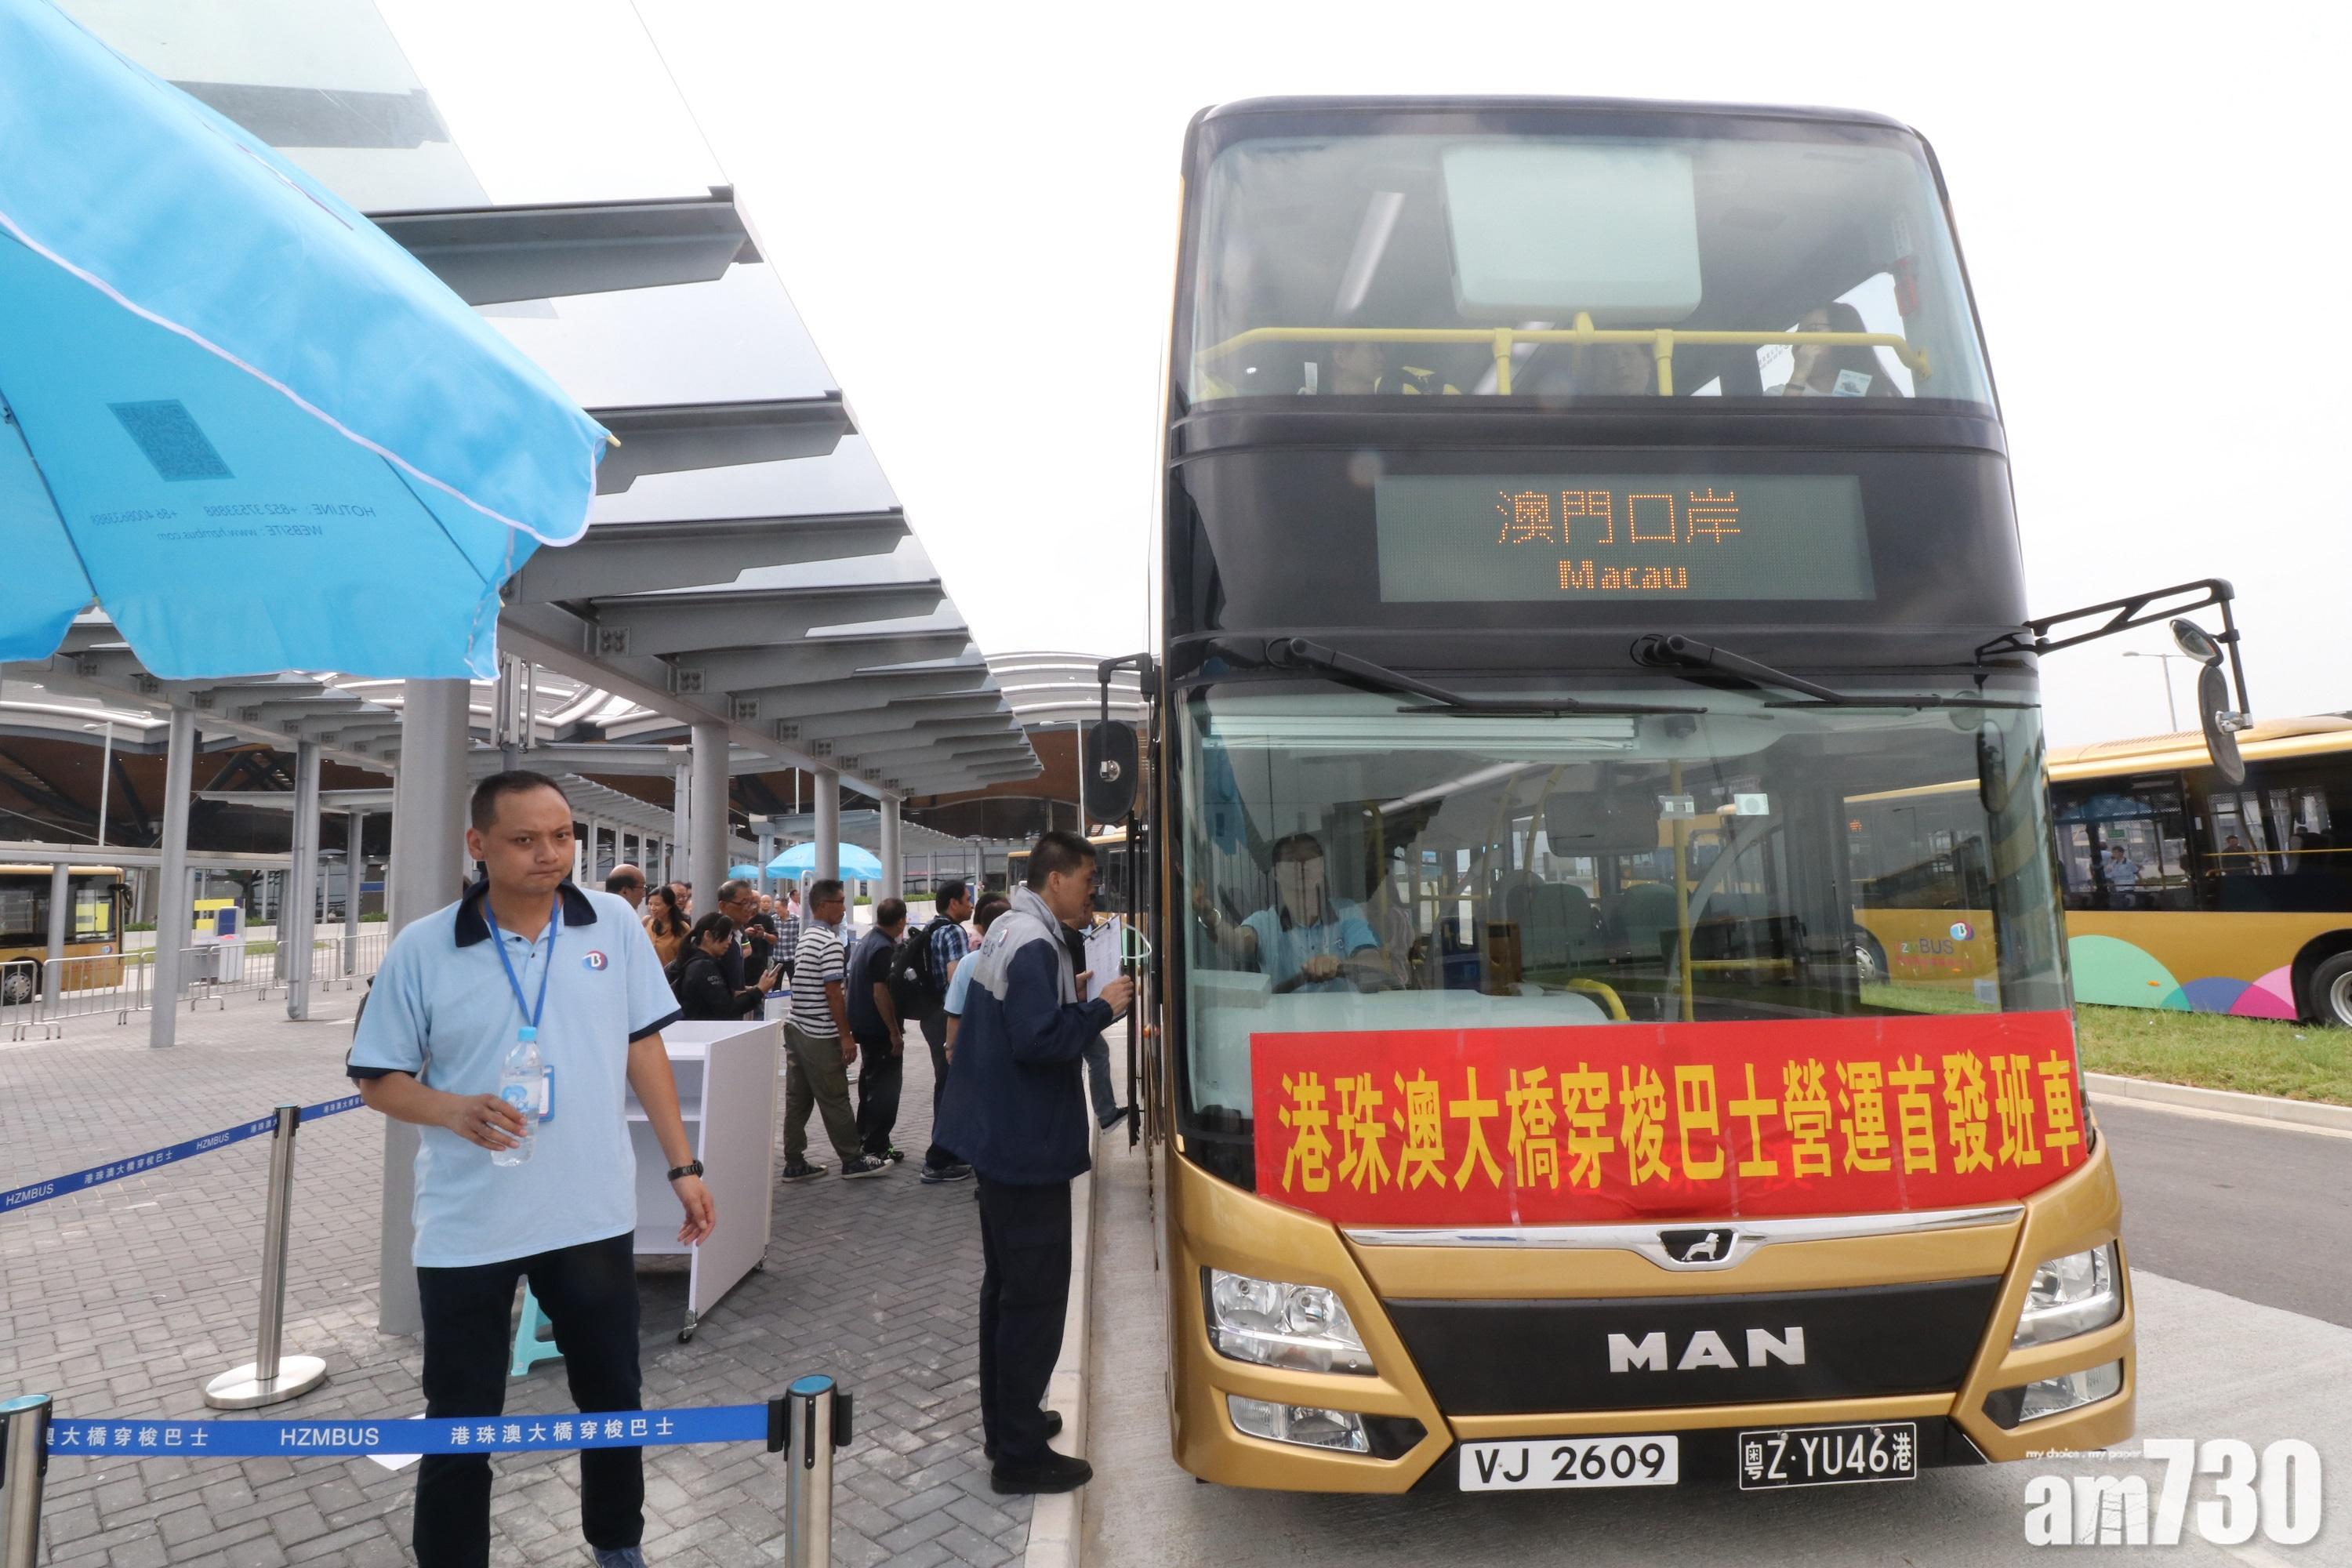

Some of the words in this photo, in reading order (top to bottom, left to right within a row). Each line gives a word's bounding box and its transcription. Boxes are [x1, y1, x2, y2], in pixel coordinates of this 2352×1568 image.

[1496, 488, 1741, 544] 澳門口岸
[1559, 560, 1689, 590] Macau
[1278, 1049, 2082, 1195] 港珠澳大橋穿梭巴士營運首發班車
[196, 1131, 230, 1151] HZMBUS
[84, 1149, 173, 1185] 港珠澳大橋穿梭巴士
[6, 1183, 54, 1207] HZMBUS
[1607, 1326, 1806, 1374] MAN
[280, 1427, 379, 1446] HZMBUS
[450, 1416, 674, 1445] 港珠澳大橋穿梭巴士
[1475, 1447, 1530, 1484] VJ
[1551, 1442, 1665, 1481] 2609
